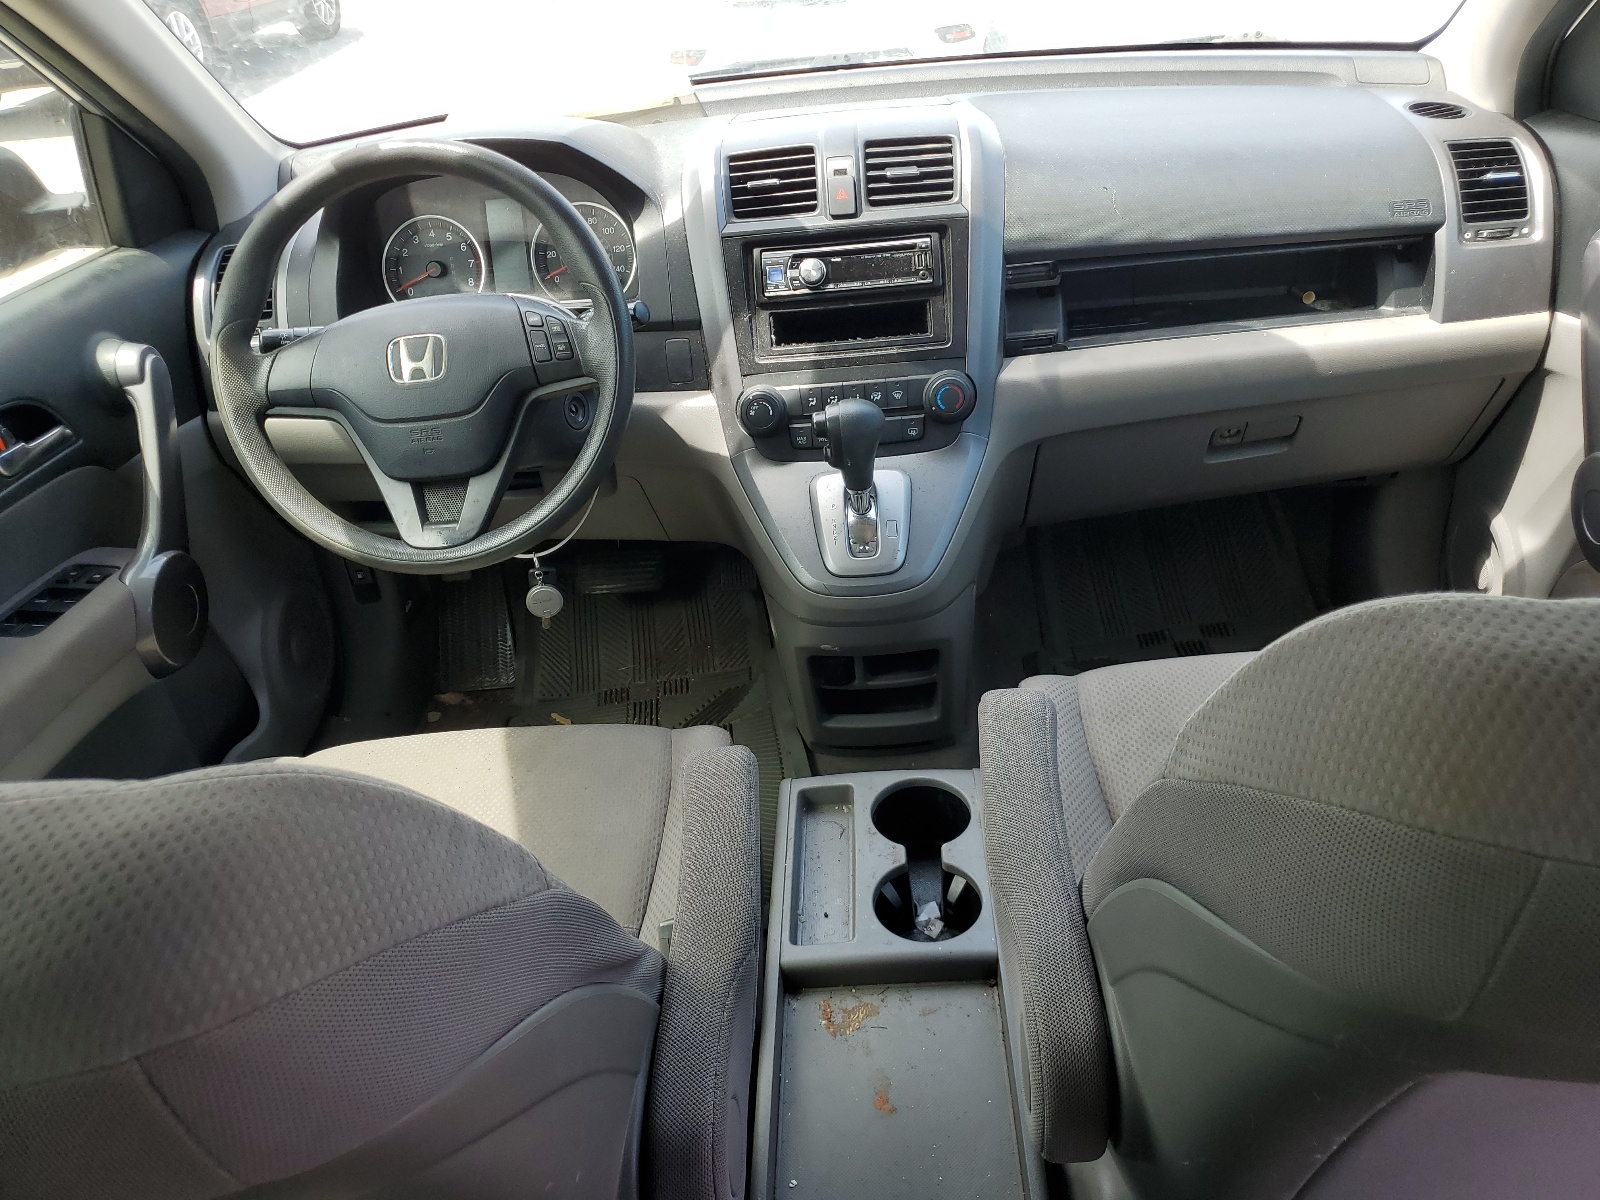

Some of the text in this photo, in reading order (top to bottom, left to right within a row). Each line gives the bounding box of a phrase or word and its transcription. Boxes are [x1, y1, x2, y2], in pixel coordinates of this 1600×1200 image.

[1393, 200, 1429, 210] SRS
[587, 217, 598, 225] 80
[428, 229, 436, 238] 4
[602, 226, 615, 235] 100
[413, 235, 419, 244] 3
[446, 232, 453, 241] 5
[460, 242, 467, 251] 6
[613, 244, 626, 253] 120
[402, 248, 409, 257] 2
[546, 250, 557, 258] 20
[467, 259, 475, 268] 7
[398, 266, 403, 275] 1
[468, 278, 475, 287] 8
[407, 288, 414, 296] 0
